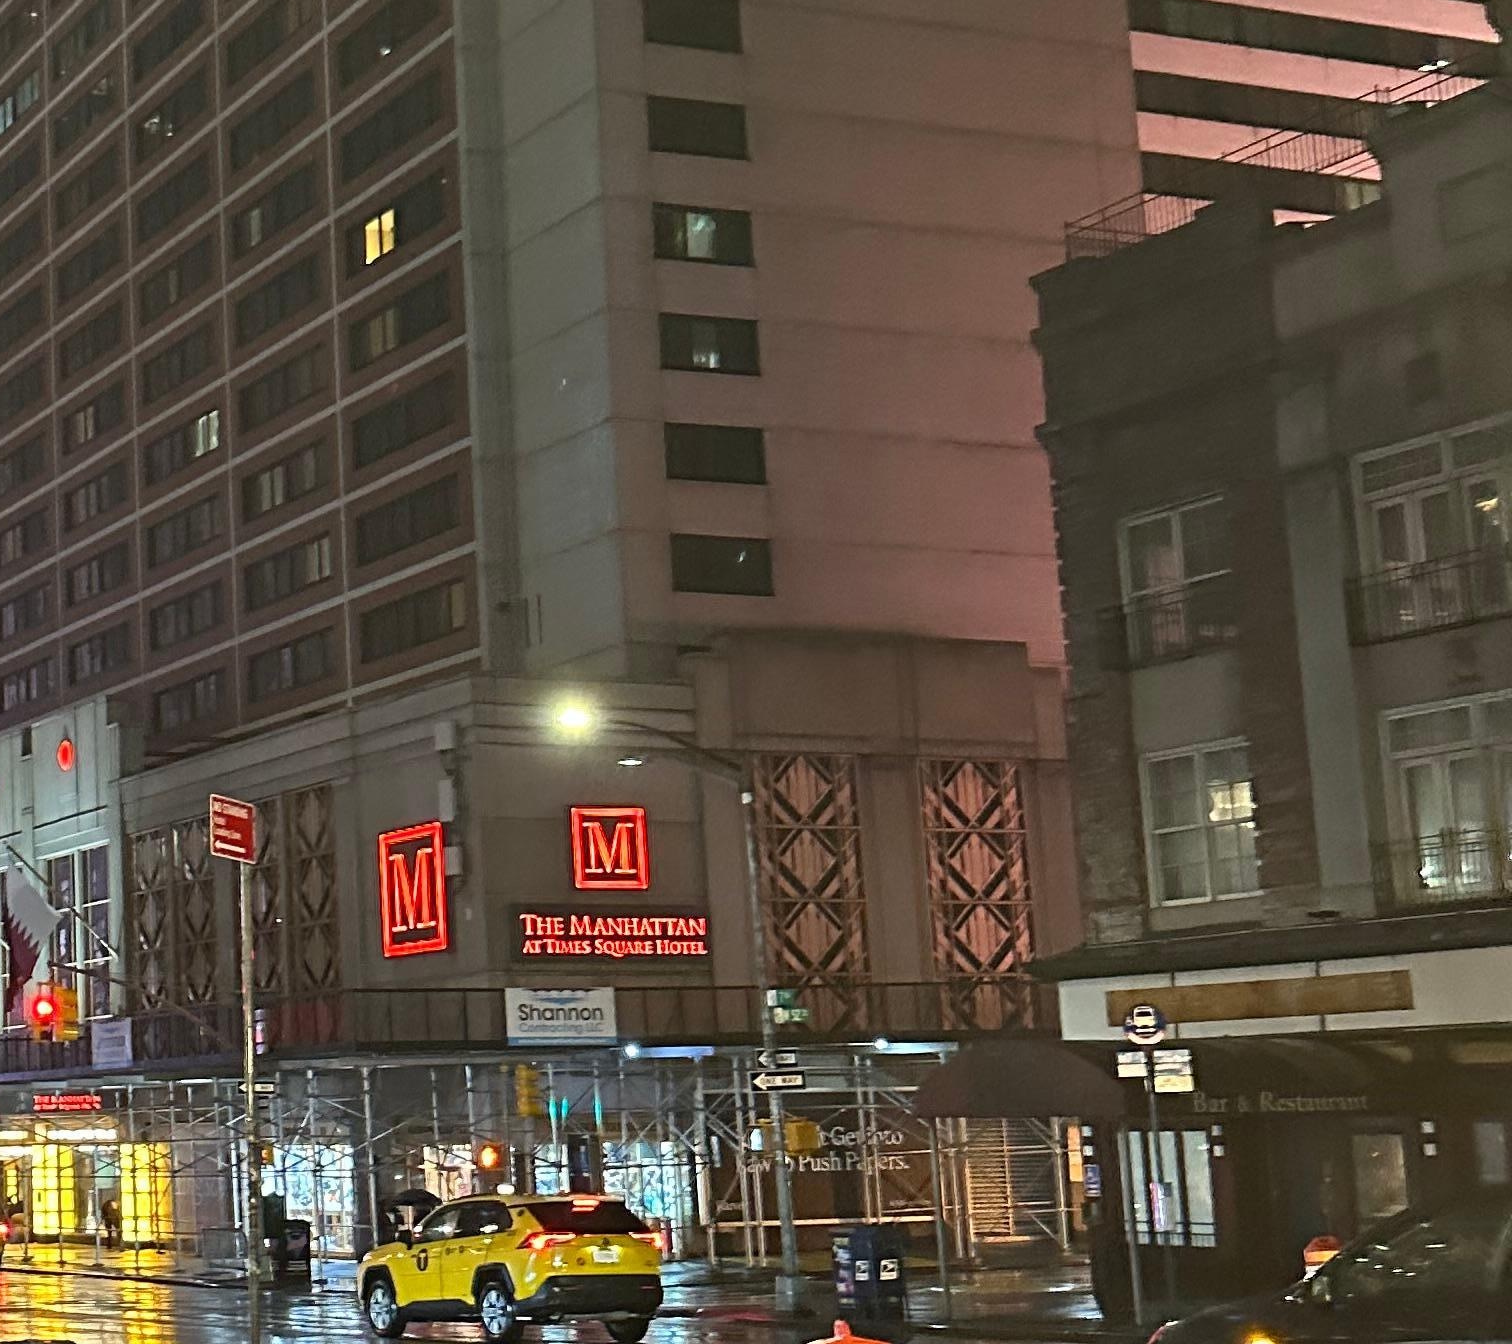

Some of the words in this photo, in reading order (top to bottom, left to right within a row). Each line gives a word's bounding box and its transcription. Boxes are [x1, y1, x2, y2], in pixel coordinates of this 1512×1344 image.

[582, 821, 637, 874] M
[389, 847, 437, 932] M
[519, 913, 565, 936] THE
[570, 914, 708, 937] MANHATTAN
[542, 938, 592, 955] TIMES
[594, 938, 655, 958] SQUARE
[656, 939, 708, 955] HOTEL
[517, 1003, 605, 1022] Shannon
[1193, 1090, 1228, 1113] Bar
[1260, 1091, 1368, 1112] Restaurant
[799, 1150, 842, 1173] Push
